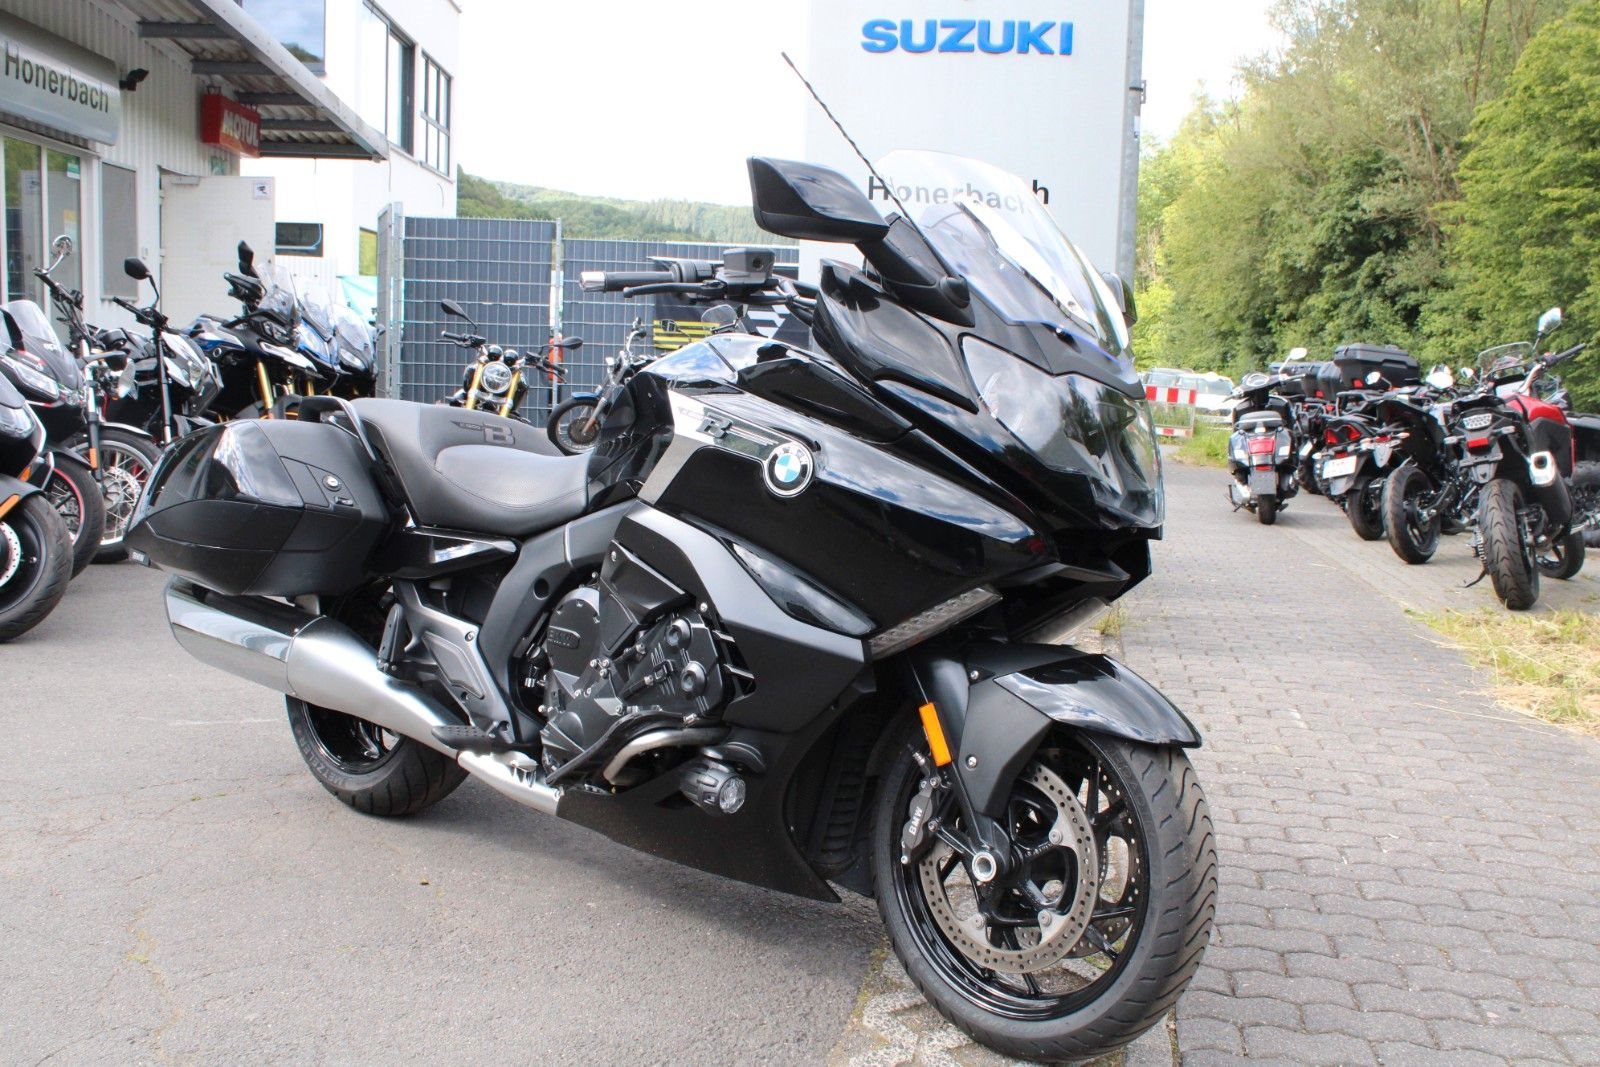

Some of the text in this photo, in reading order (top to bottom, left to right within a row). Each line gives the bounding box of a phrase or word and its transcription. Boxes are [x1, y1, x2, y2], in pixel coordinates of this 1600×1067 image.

[861, 19, 1073, 55] SUZUKI
[5, 40, 109, 113] Honerbach
[223, 108, 259, 148] MOTUL
[909, 806, 923, 836] BMW
